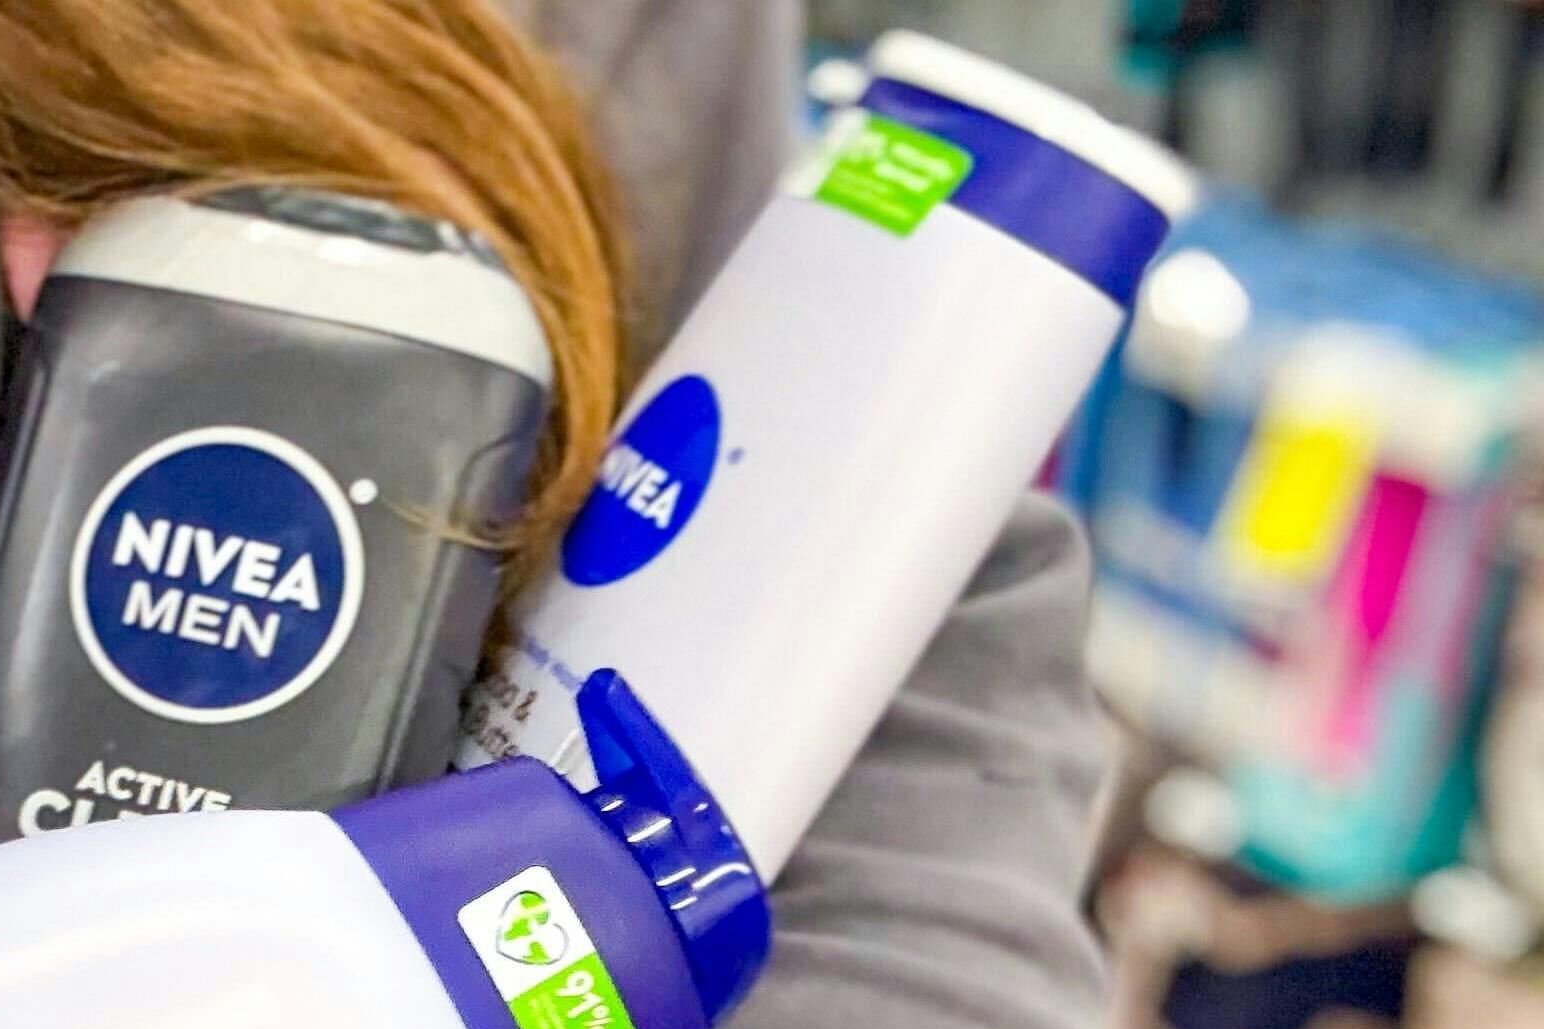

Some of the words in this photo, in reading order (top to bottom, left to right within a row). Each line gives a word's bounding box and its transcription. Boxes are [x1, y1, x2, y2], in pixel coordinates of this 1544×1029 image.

[112, 511, 320, 611] NIVEA
[122, 580, 281, 658] MEN
[75, 760, 232, 812] ACTIVE
